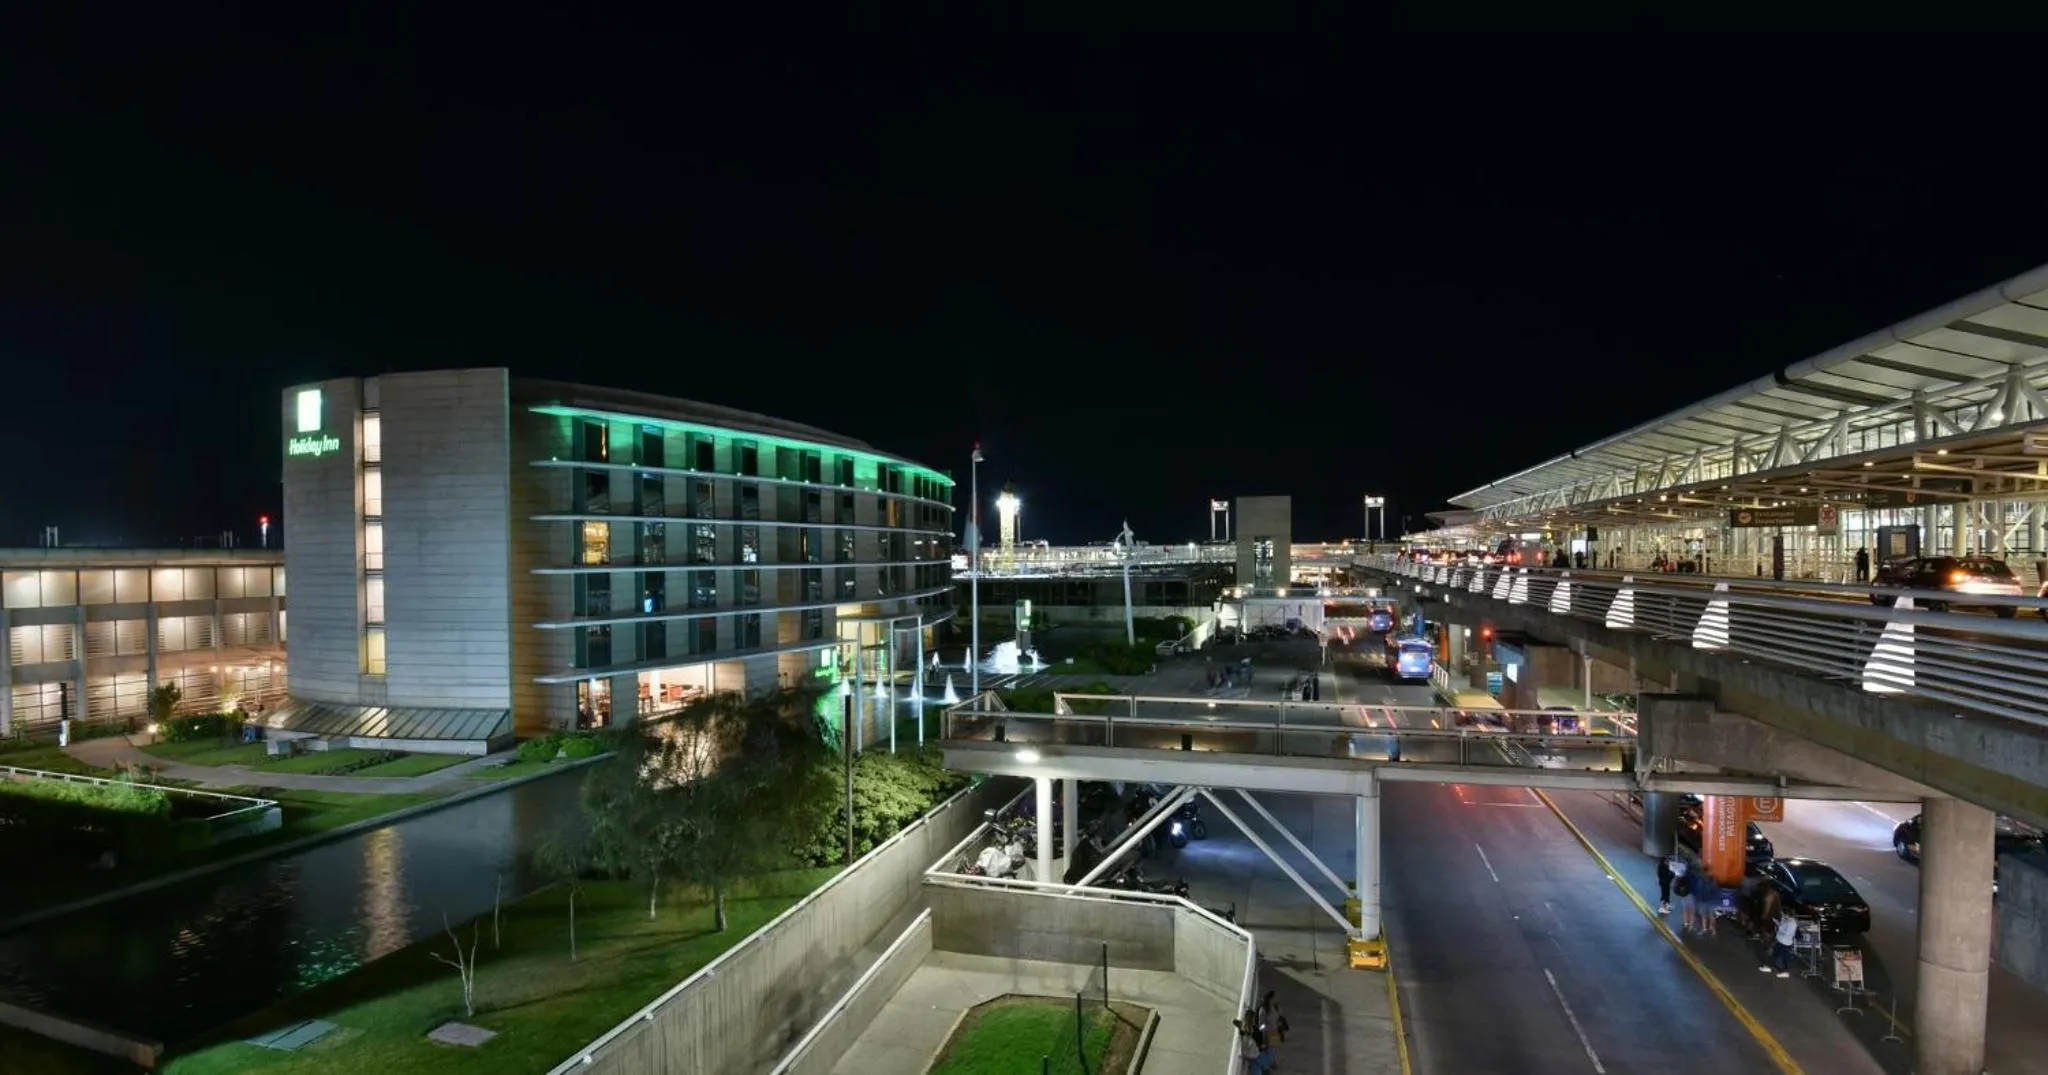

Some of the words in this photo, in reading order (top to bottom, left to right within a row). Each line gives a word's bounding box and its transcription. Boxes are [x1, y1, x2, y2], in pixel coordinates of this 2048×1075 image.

[289, 437, 322, 456] Holiday
[323, 434, 340, 452] Inn
[1727, 796, 1737, 837] PATAGU
